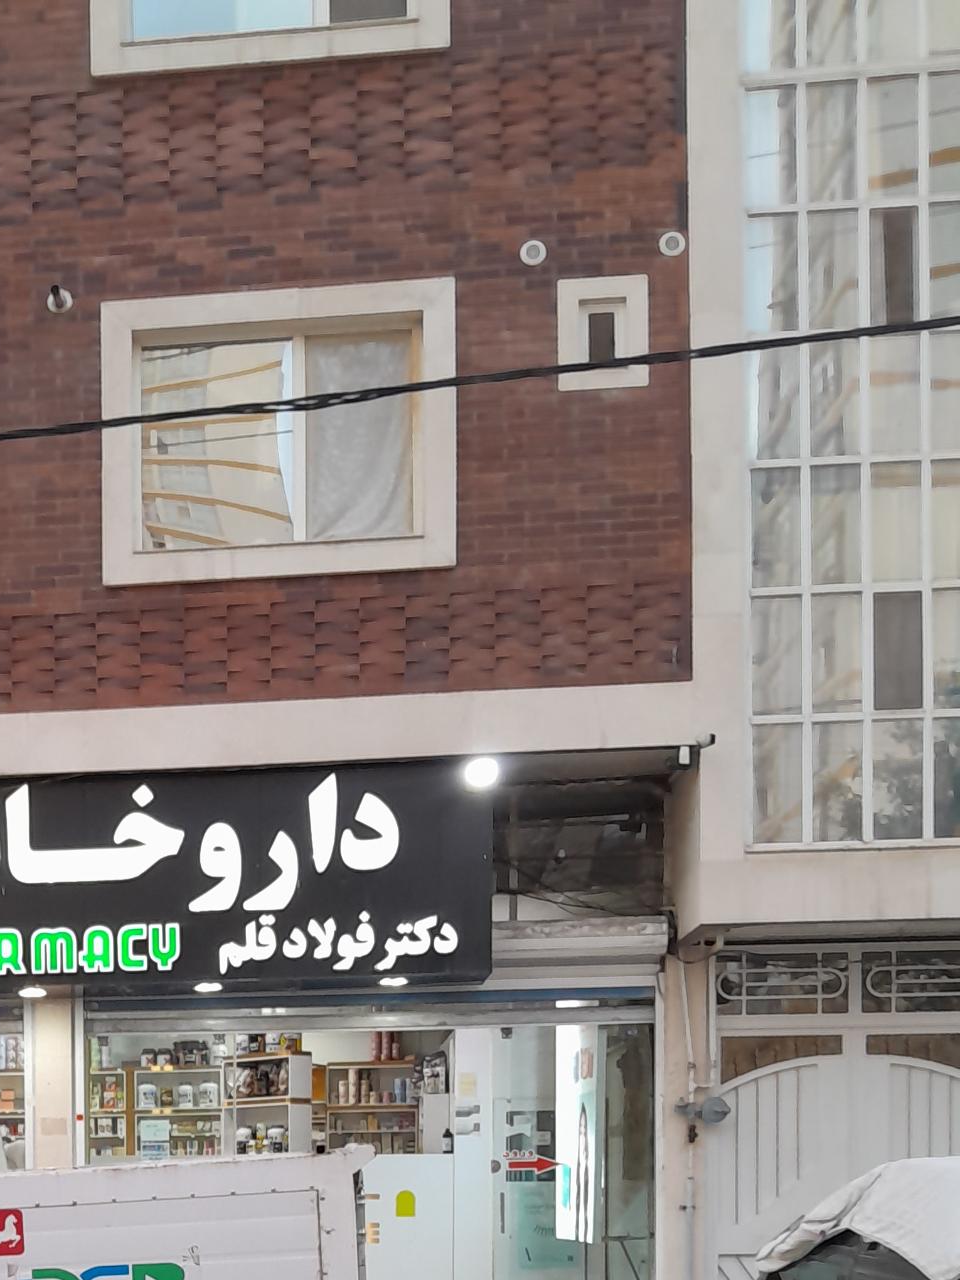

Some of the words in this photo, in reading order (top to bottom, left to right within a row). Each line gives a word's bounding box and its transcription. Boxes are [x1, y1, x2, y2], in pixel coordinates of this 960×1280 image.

[219, 914, 277, 975] قلم
[282, 910, 375, 971] فولاد
[374, 915, 458, 971] دکتر
[503, 1150, 534, 1158] ورود
